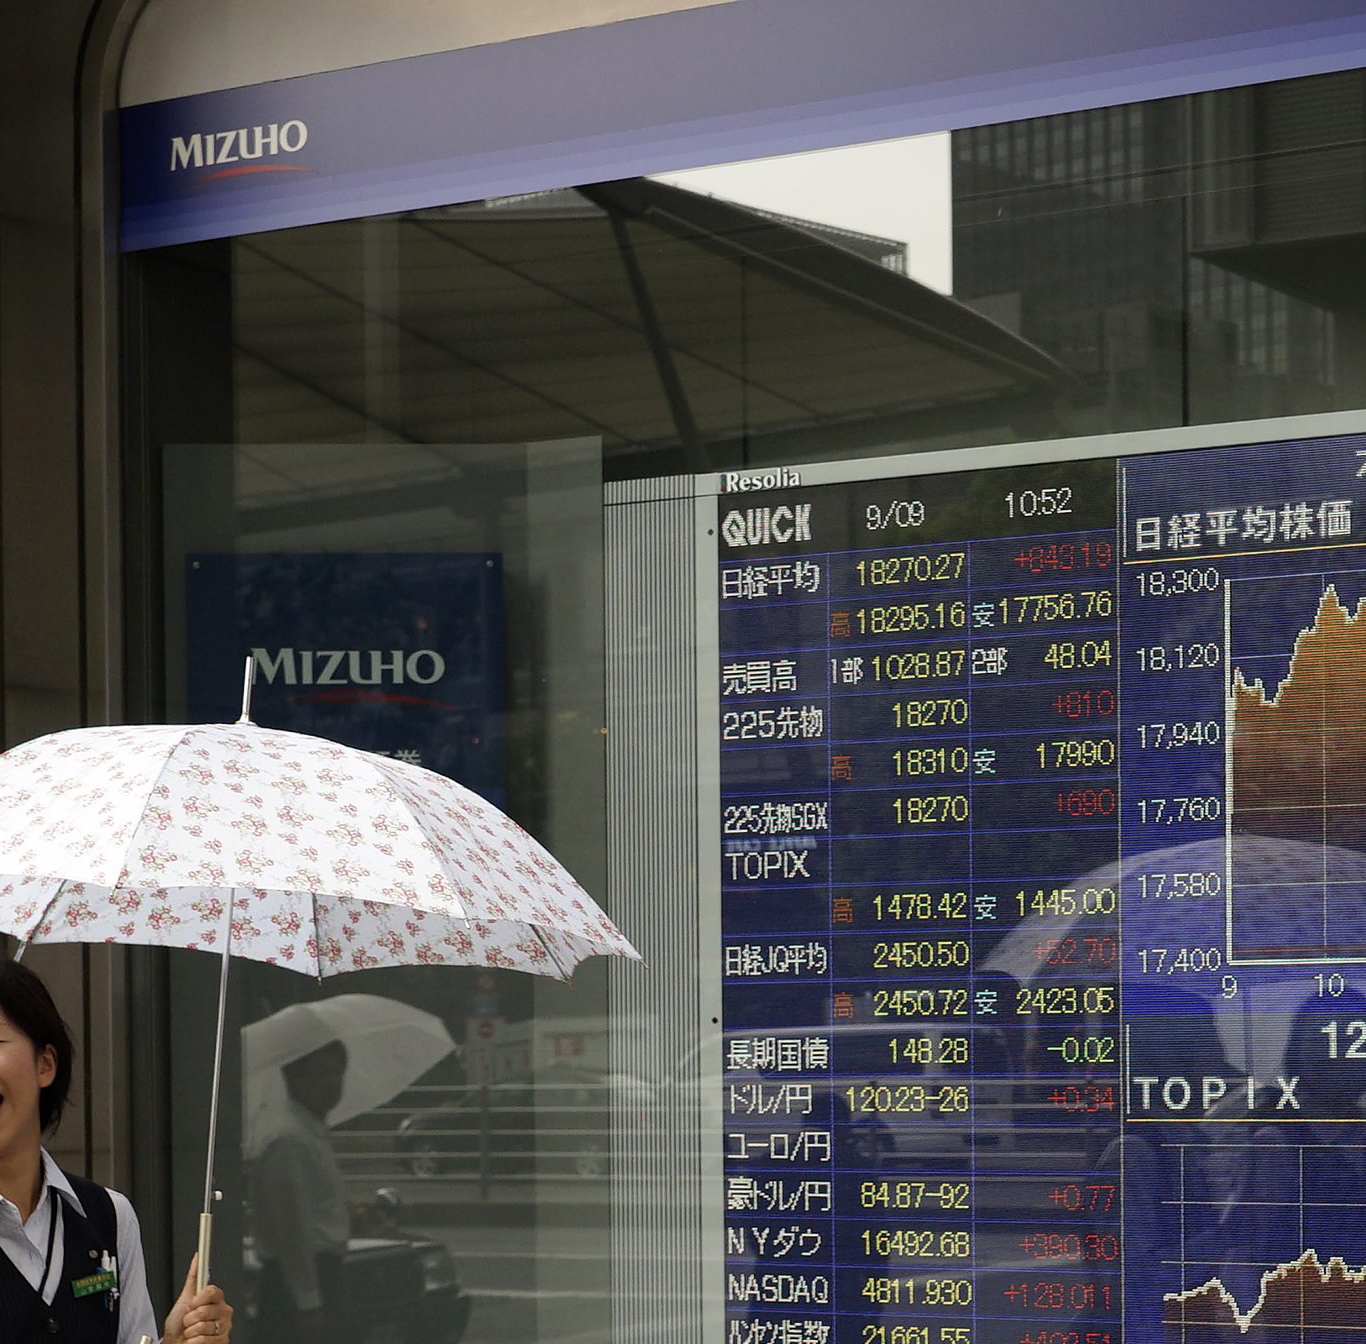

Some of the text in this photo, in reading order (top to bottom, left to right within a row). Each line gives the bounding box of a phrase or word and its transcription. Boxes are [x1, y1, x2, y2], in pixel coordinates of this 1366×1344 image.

[170, 119, 308, 171] MIZUHO
[725, 469, 801, 492] Resolia
[721, 487, 1072, 547] QUICK 9/09 10:52
[1136, 500, 1353, 552] 日経平均株価
[721, 560, 820, 600] 日経平均
[856, 553, 965, 586] 18270.27
[1136, 568, 1219, 596] 18,300
[856, 602, 965, 635] 18295.16
[999, 591, 1112, 625] 17756.76
[251, 648, 445, 685] MIZUHO
[723, 659, 797, 696] 売買高
[871, 650, 965, 681] 1028.87
[971, 648, 1008, 676] 2部
[1044, 641, 1112, 670] 48.04
[1136, 643, 1219, 672] 18,120
[723, 706, 824, 740] 225先物
[892, 699, 969, 729] 18270
[1137, 720, 1221, 750] 17,940
[892, 747, 969, 777] 18310
[972, 749, 996, 775] 安
[1036, 740, 1114, 769] 17990
[892, 796, 969, 824] 18270
[1137, 796, 1221, 825] 17,760
[725, 850, 811, 880] TOPIX
[1137, 872, 1221, 901] 17,580
[873, 893, 967, 921] 1478.42
[974, 895, 998, 920] 安
[1015, 889, 1116, 917] 1445.00
[725, 942, 827, 977] 日経JQ平均
[873, 942, 969, 970] 2450.50
[1137, 947, 1222, 975] 17,400
[1221, 975, 1239, 1000] 9
[1314, 972, 1345, 998] 10
[874, 990, 968, 1017] 2450.72
[976, 990, 998, 1015] 安
[1016, 988, 1115, 1014] 2423.05
[727, 1036, 829, 1071] 長期国債
[889, 1038, 969, 1065] 148.28
[730, 1084, 813, 1116] ドル/円
[1047, 1087, 1115, 1113] +0.34
[1132, 1076, 1301, 1111] TOPIX
[727, 1132, 832, 1162] ユーロ/円
[727, 1175, 832, 1212] 豪ドル/円
[1049, 1184, 1115, 1212] +0.77
[861, 1230, 970, 1259] 16492.68
[728, 1273, 829, 1303] NASDAQ
[862, 1277, 972, 1305] 4811.930
